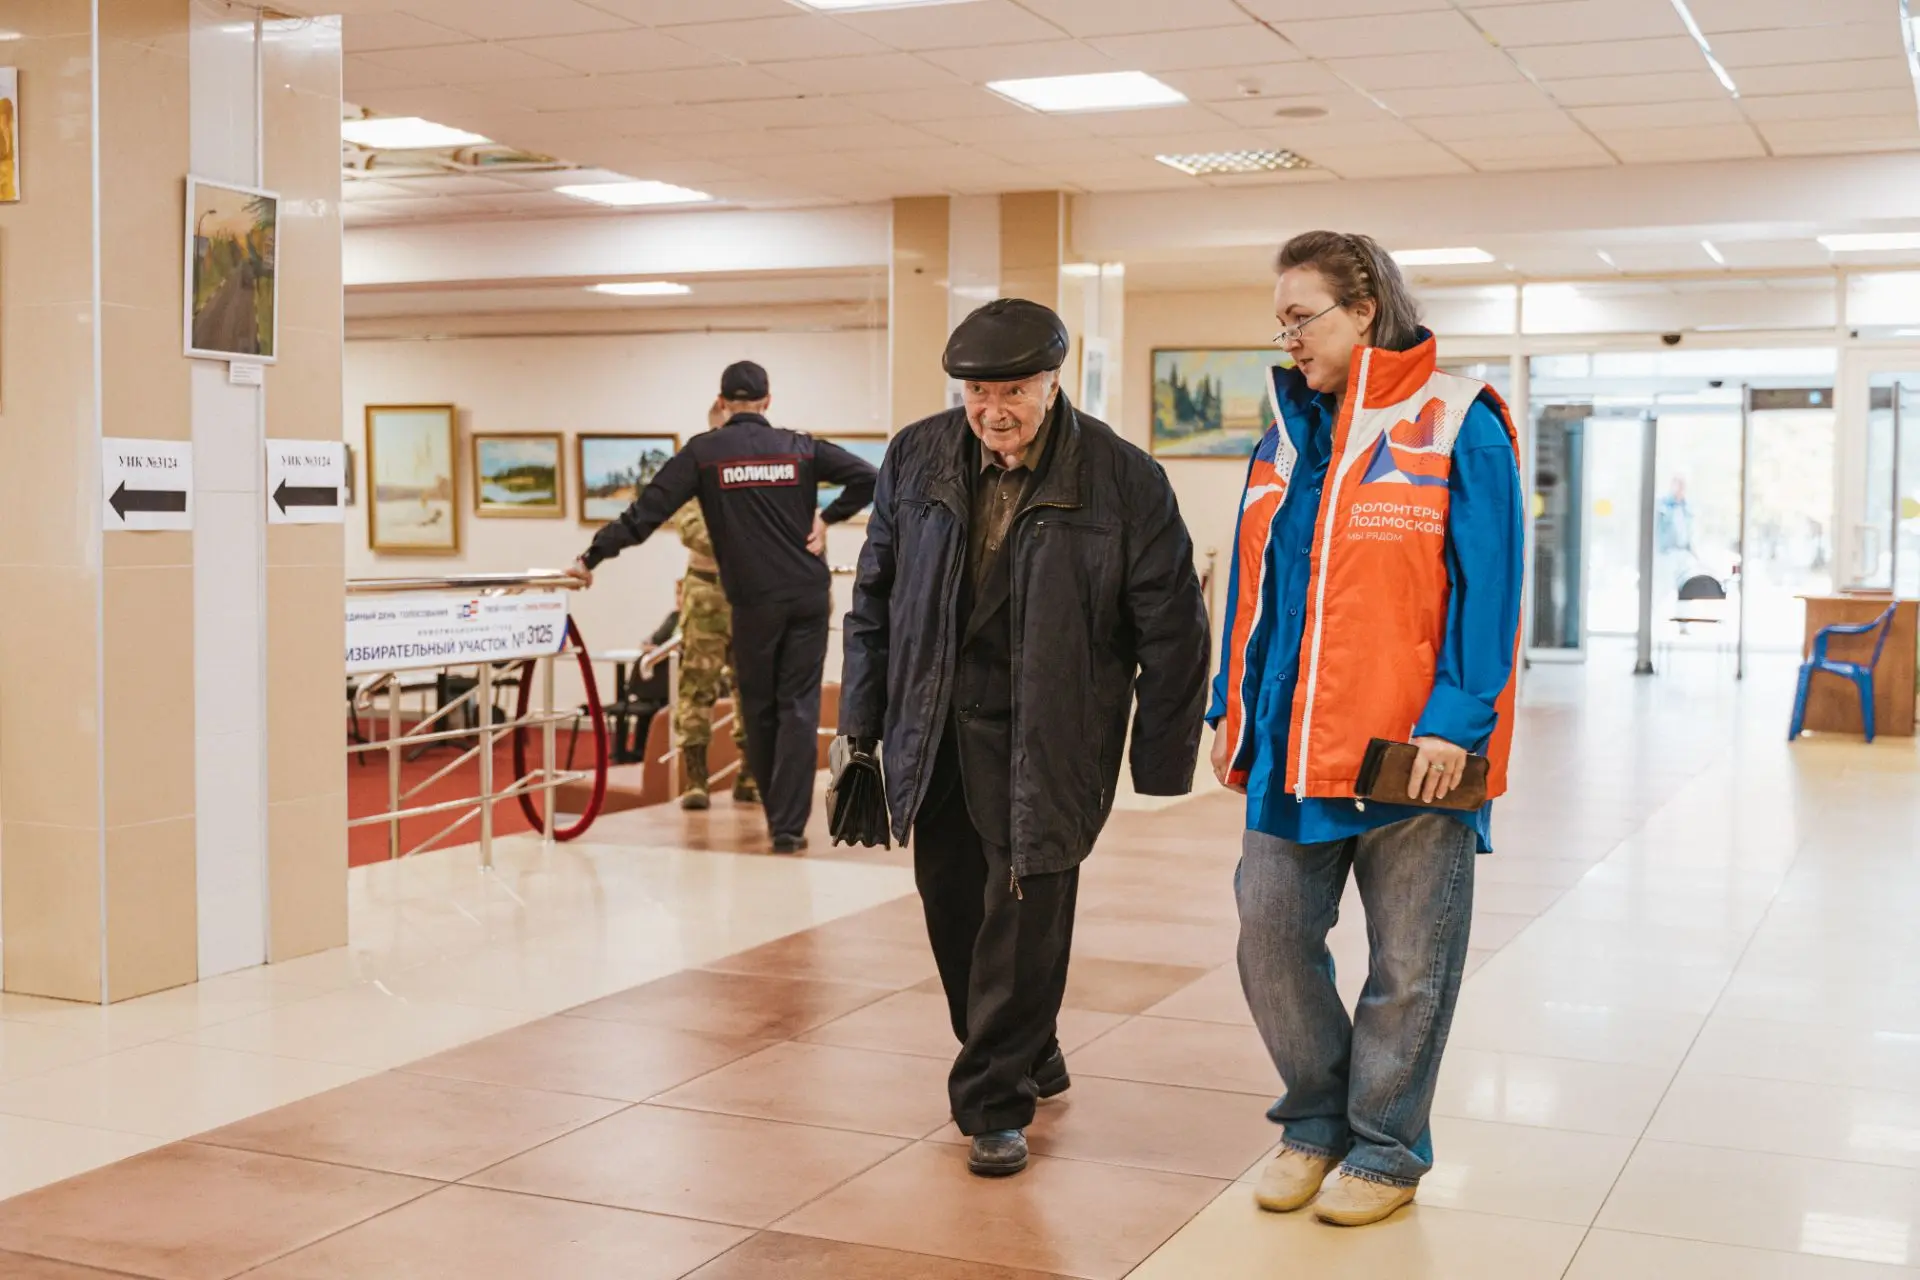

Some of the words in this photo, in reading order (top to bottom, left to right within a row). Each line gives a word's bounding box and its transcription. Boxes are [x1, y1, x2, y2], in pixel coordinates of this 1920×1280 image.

[119, 455, 142, 468] УИК
[146, 456, 178, 469] №3124
[281, 455, 302, 467] УИК
[723, 464, 795, 484] ПОЛИЦИЯ
[1351, 502, 1444, 520] ВОЛОНТЕРЫ
[1347, 531, 1364, 541] МЫ
[1366, 531, 1403, 542] РЯДОМ
[345, 638, 455, 662] ИЗБИРАТЕЛЬНЫЙ
[459, 636, 508, 653] УЧАСТОК
